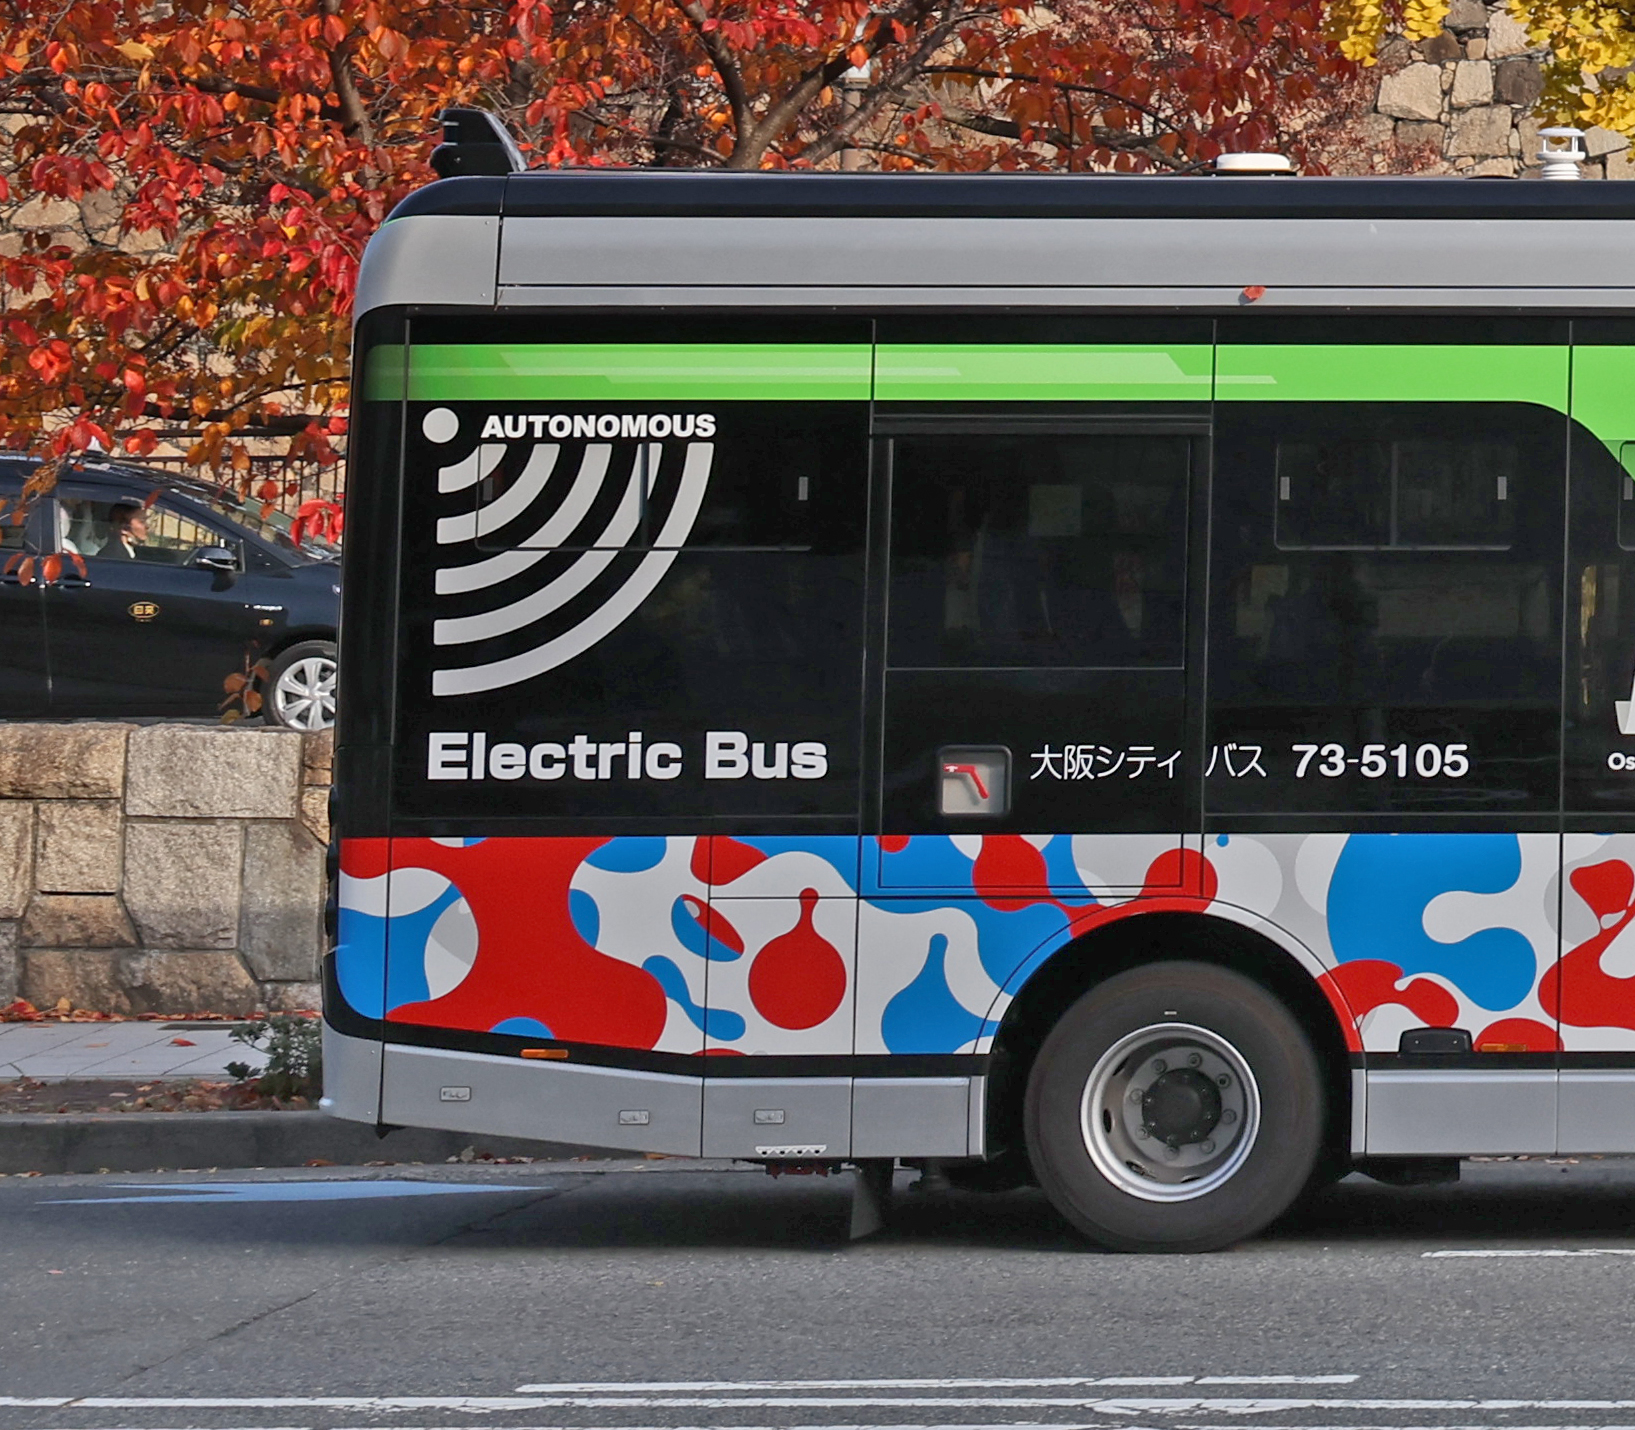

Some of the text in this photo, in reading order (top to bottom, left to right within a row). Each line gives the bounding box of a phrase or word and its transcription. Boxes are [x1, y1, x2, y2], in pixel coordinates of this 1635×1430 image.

[481, 414, 716, 438] AUTONOMOUS
[428, 732, 828, 780] Electric Bus
[1292, 744, 1469, 778] 73-5105
